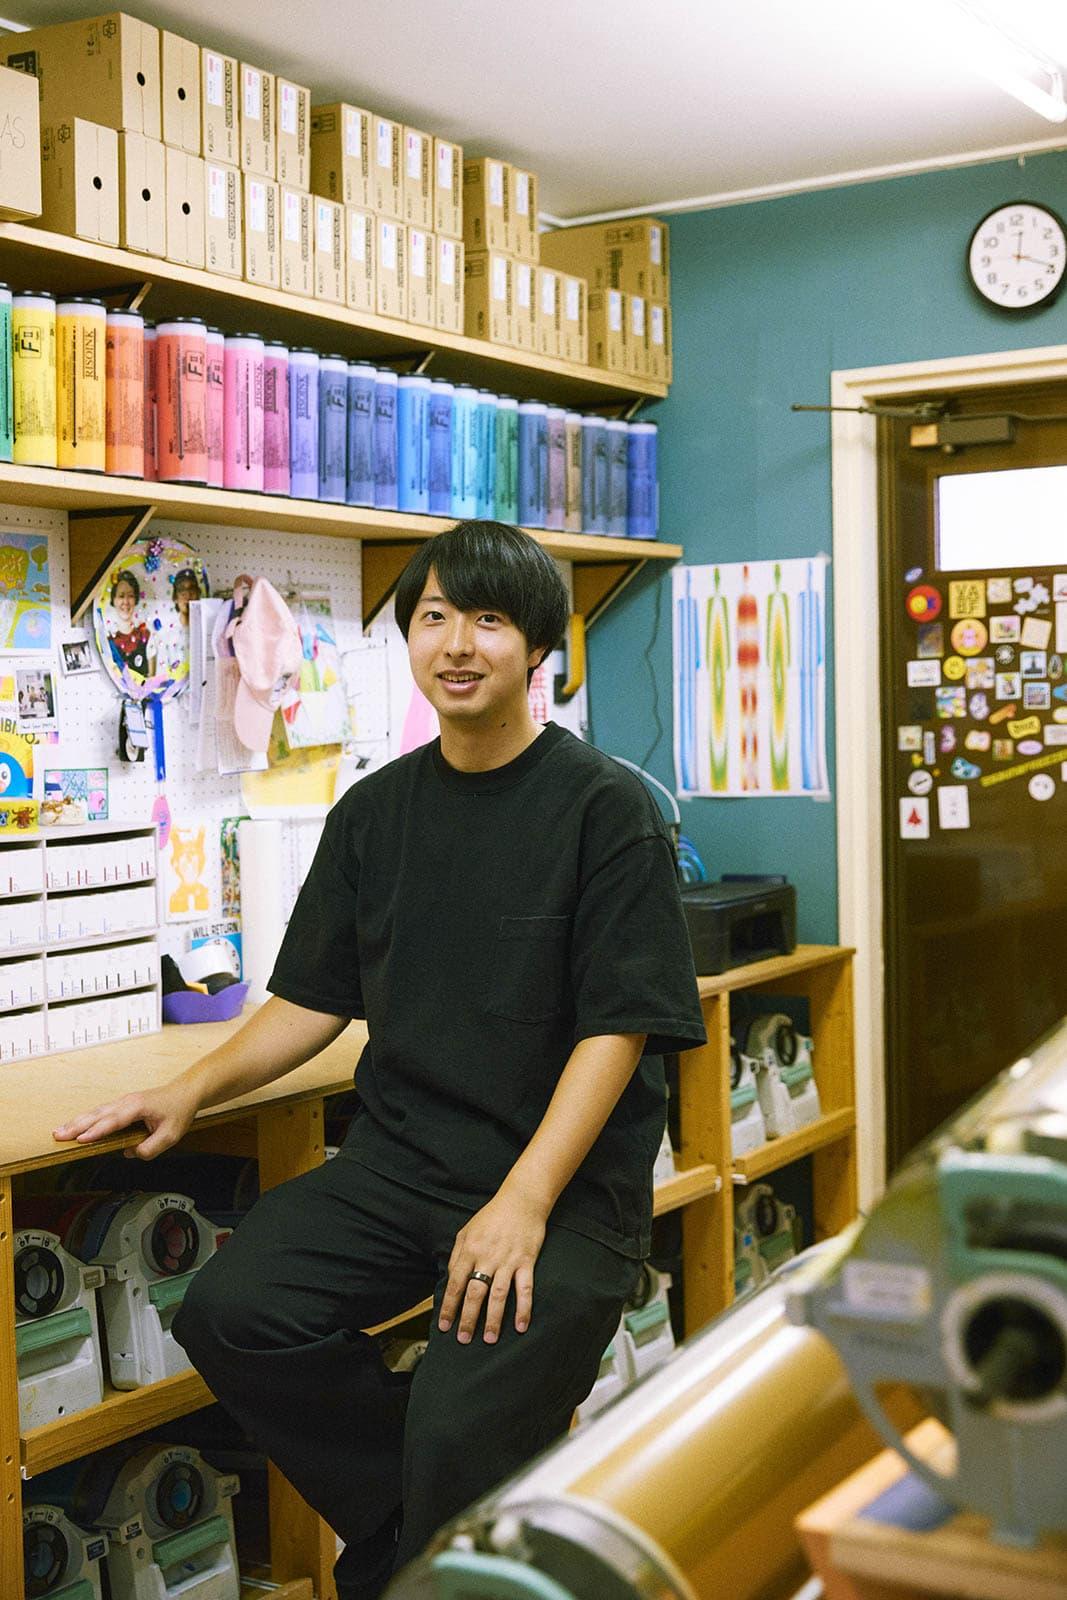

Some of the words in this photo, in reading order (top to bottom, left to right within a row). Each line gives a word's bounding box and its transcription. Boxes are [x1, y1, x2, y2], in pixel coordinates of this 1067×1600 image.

[1009, 213, 1024, 226] 12
[1043, 227, 1053, 240] 2
[984, 236, 998, 248] 10
[1050, 244, 1058, 257] 3
[981, 256, 991, 268] 9
[987, 272, 997, 285] 8
[1034, 279, 1044, 290] 5
[1001, 282, 1009, 295] 7
[1018, 286, 1028, 297] 6
[211, 921, 239, 936] RETURN
